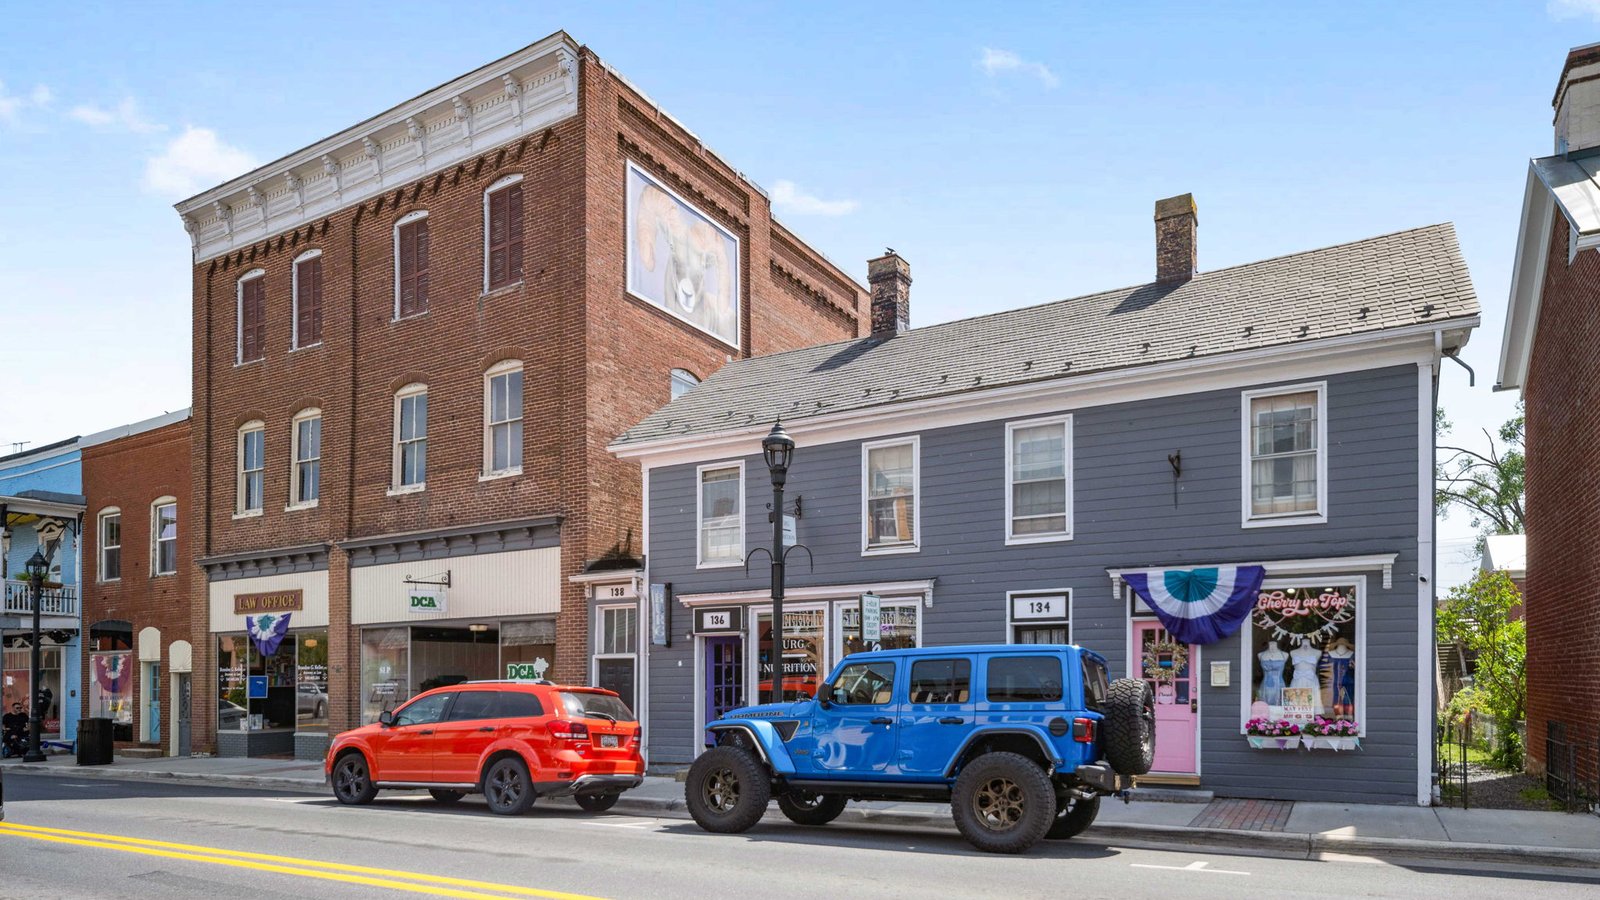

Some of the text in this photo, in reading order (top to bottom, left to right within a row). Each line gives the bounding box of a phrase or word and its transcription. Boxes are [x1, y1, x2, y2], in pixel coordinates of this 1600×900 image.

[610, 588, 625, 597] 138
[239, 594, 295, 610] LAW OFFICE
[411, 596, 437, 607] DCA
[1257, 591, 1347, 617] Cherry on Top
[1030, 602, 1051, 613] 134
[710, 616, 725, 625] 136
[782, 639, 805, 649] URG
[508, 664, 536, 679] DCA
[764, 663, 817, 673] NRITION
